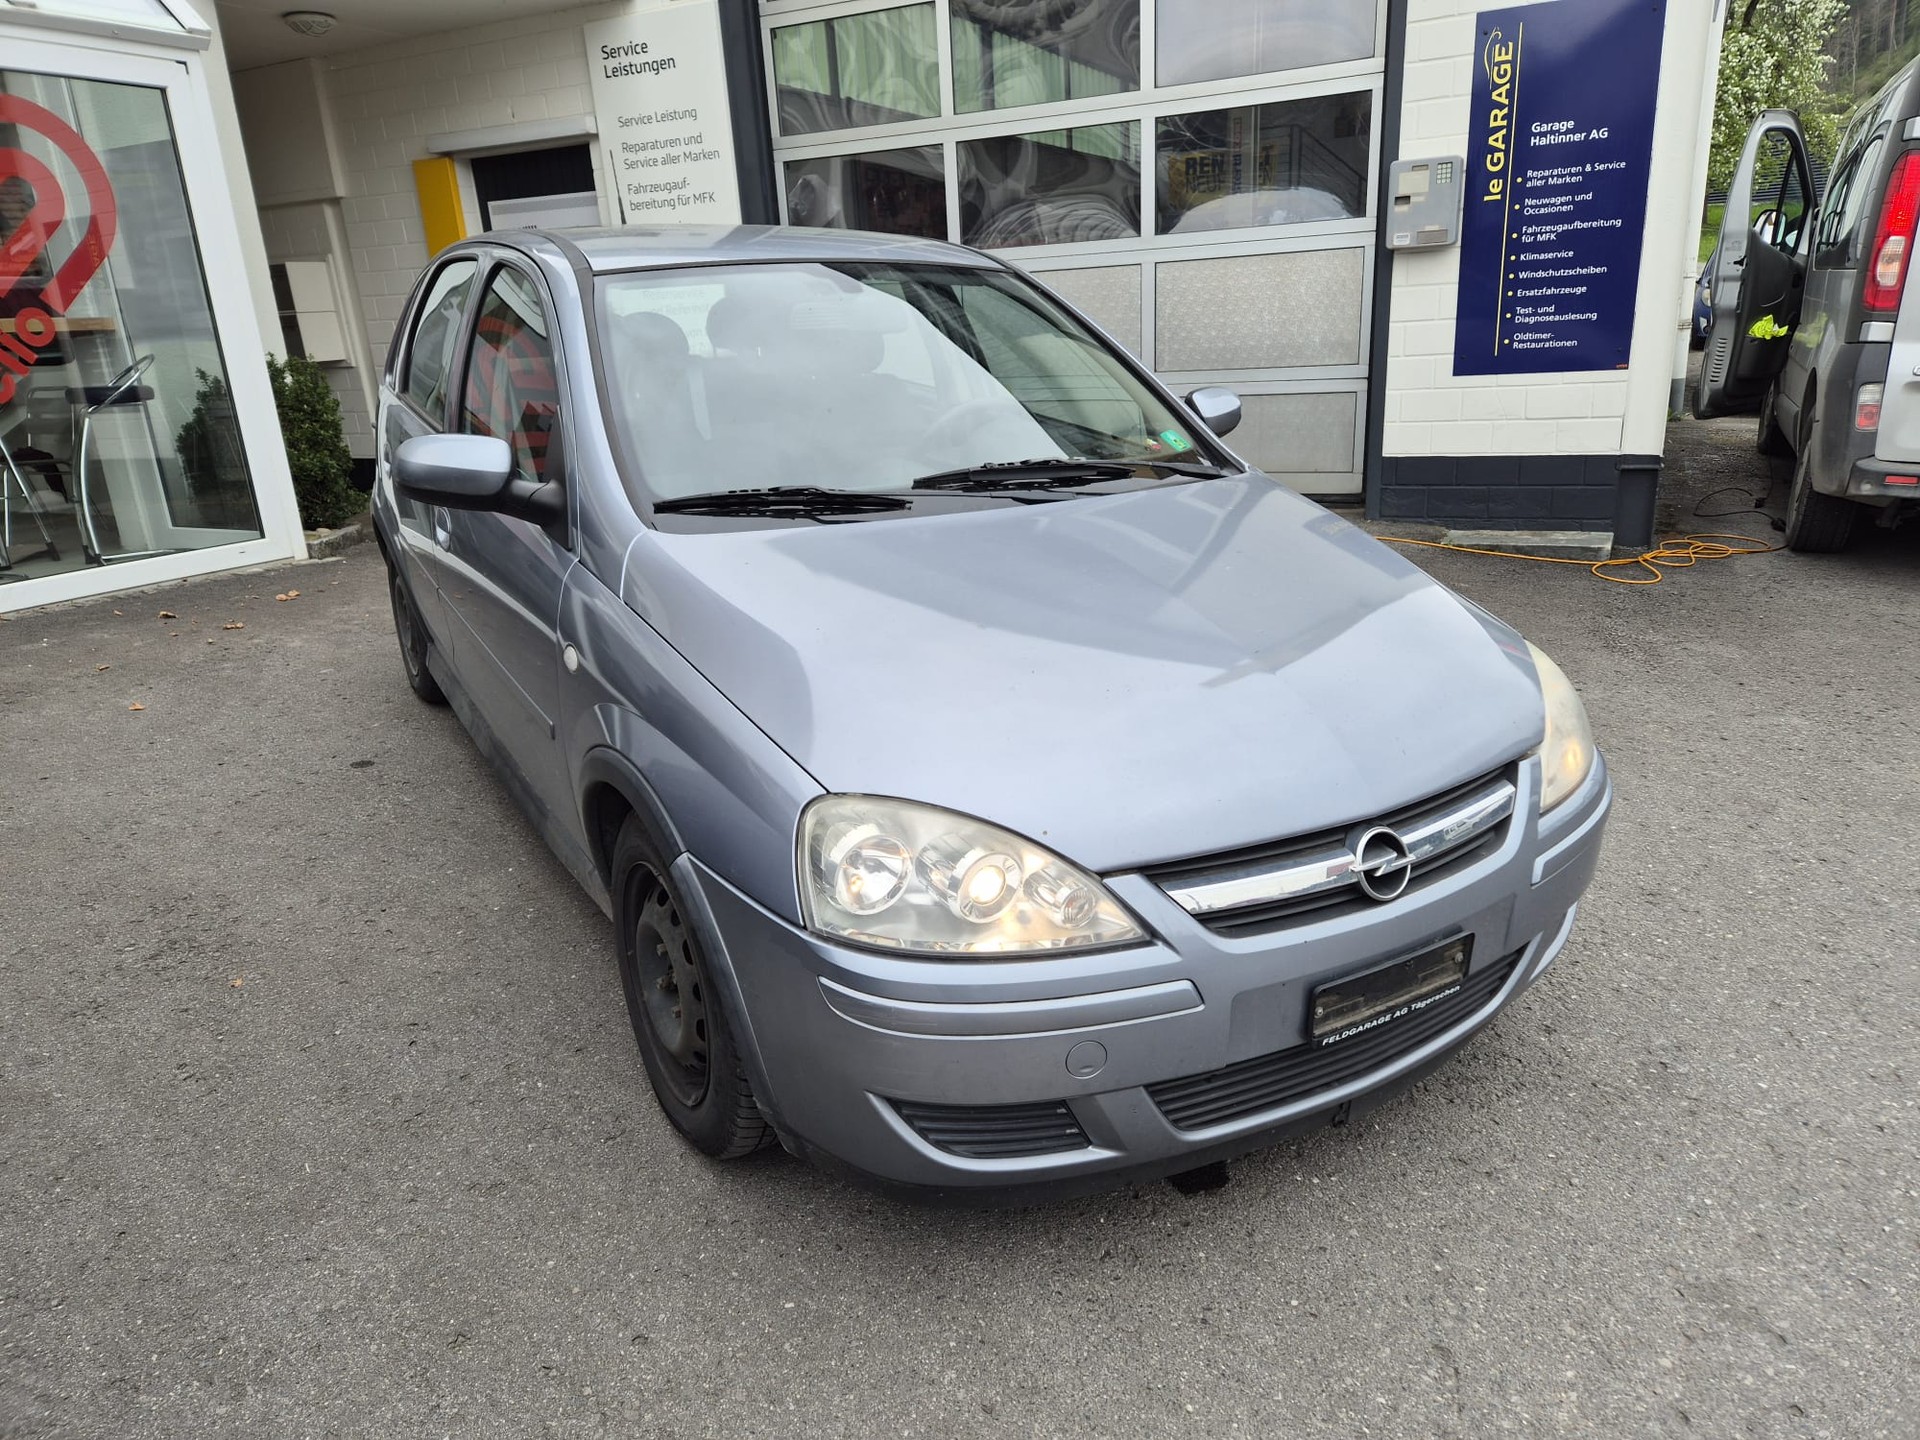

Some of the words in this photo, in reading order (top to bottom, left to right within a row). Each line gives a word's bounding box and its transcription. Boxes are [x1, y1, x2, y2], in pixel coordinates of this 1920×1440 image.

[601, 41, 648, 60] Service
[604, 56, 676, 78] Leistungen
[1486, 41, 1513, 172] GARAGE
[618, 113, 653, 128] Service
[655, 107, 697, 125] Leistung
[1531, 120, 1575, 135] Garage
[621, 138, 682, 153] Reparaturen
[683, 132, 703, 146] und
[1530, 129, 1587, 146] Haltinner
[1588, 128, 1609, 140] AG
[623, 157, 659, 170] Service
[660, 152, 681, 166] aller
[683, 149, 720, 163] Marken
[1527, 165, 1582, 179] Reparaturen
[1585, 163, 1592, 172] &
[1594, 161, 1626, 171] Service
[627, 177, 690, 195] Fahrzeugauf-
[1526, 177, 1545, 188] aller
[1548, 174, 1583, 186] Marken
[1484, 178, 1503, 201] le
[629, 195, 676, 211] bereitung
[677, 193, 691, 206] für
[693, 191, 716, 204] MFK
[1524, 195, 1572, 208] Neuwagen
[1575, 192, 1593, 202] und
[1523, 204, 1574, 216] Occasionen
[1522, 218, 1622, 234] Fahrzeugaufbereitung
[1521, 234, 1535, 243] für
[1536, 233, 1557, 242] MFK
[1520, 249, 1574, 261] Klimaservice
[1518, 265, 1607, 279] Windschutzscheiben
[1517, 285, 1587, 298] Ersatzfahrzeuge
[1516, 306, 1536, 314] Test-
[1537, 304, 1555, 313] und
[1515, 311, 1598, 324] Diagnoseauslesung
[1513, 331, 1555, 341] Oldtimer-
[1513, 339, 1578, 350] Restaurationen
[1322, 1013, 1392, 1046] FELDGARAGE
[1393, 1006, 1409, 1020] AG
